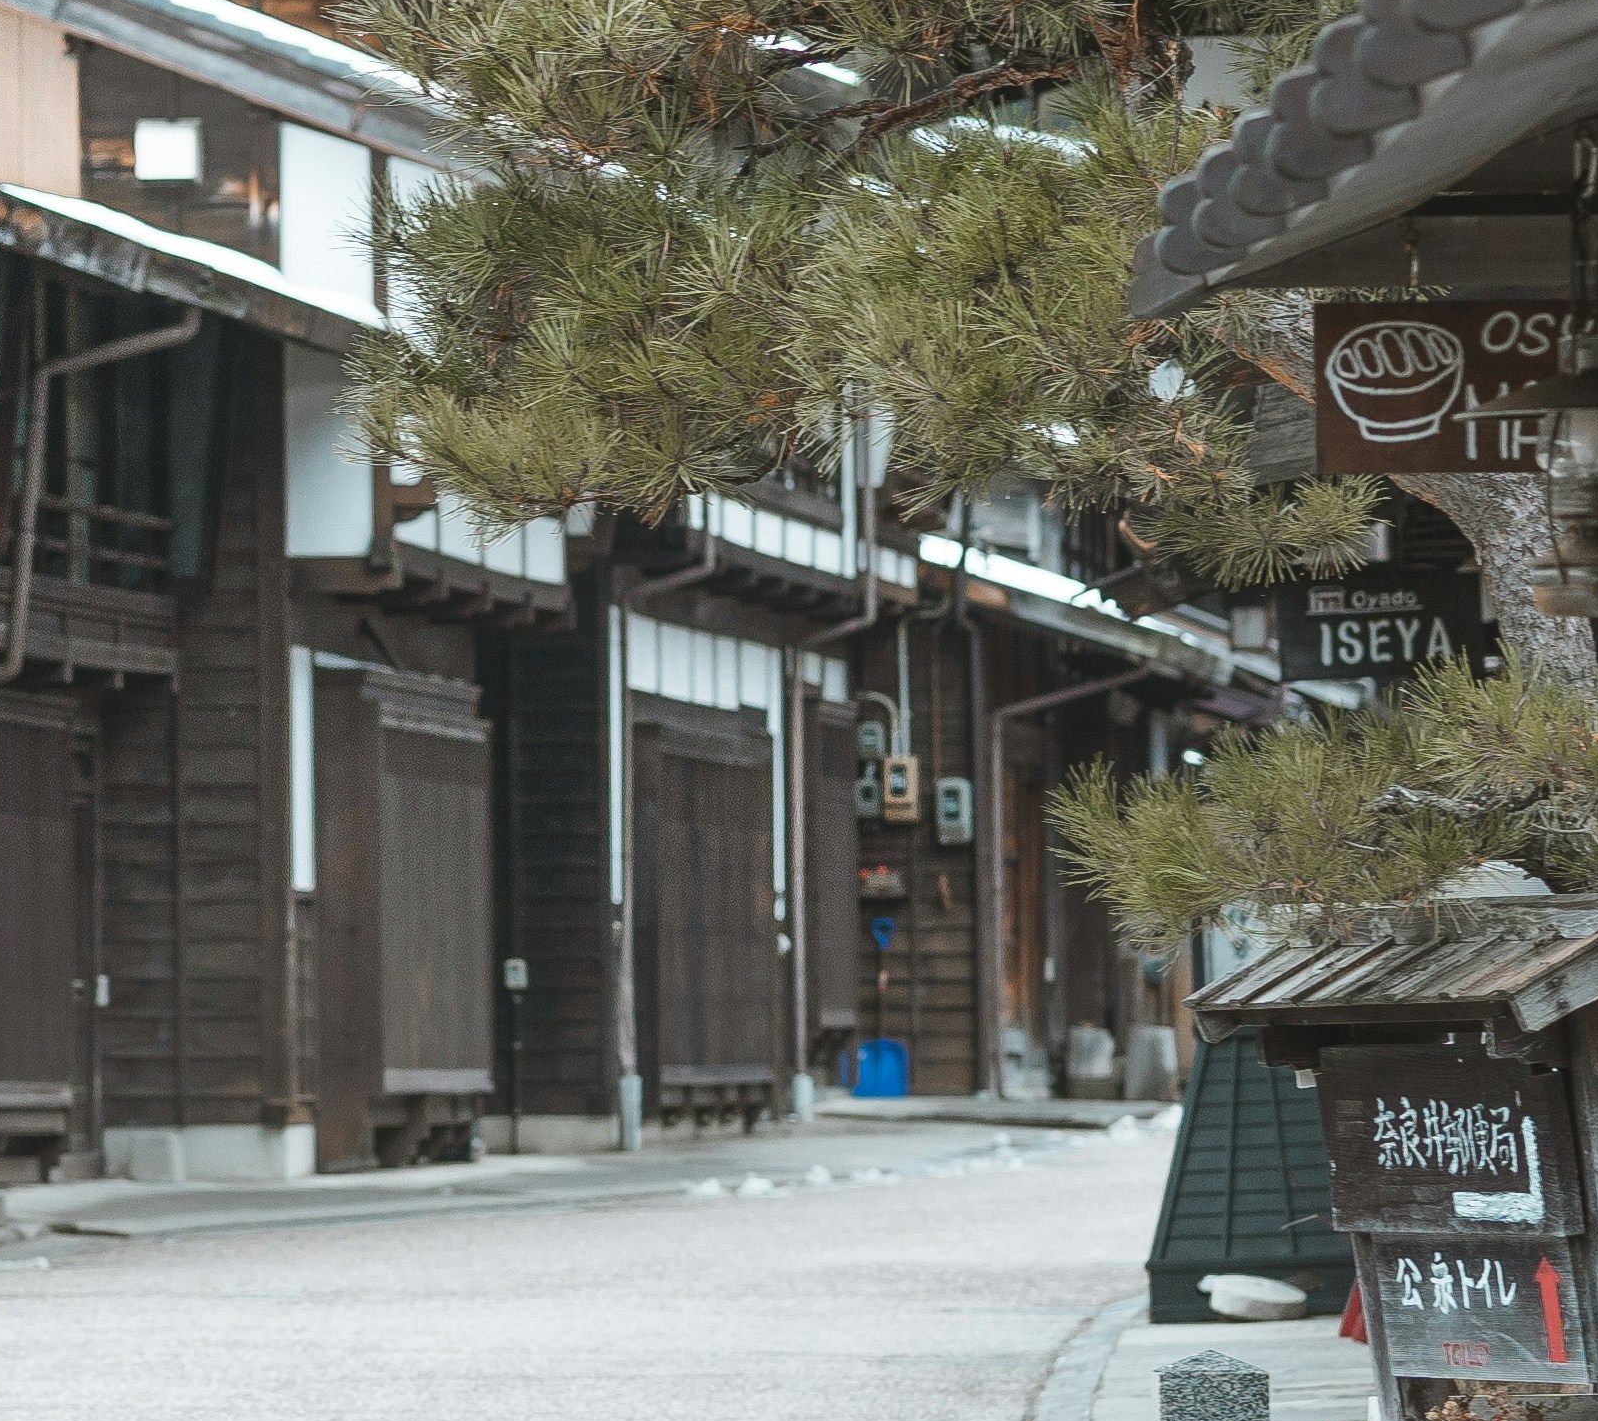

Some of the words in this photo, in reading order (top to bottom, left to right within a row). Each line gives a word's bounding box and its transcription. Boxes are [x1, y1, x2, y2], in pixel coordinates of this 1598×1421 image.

[1350, 589, 1418, 611] Oyado
[1319, 617, 1452, 667] ISEYA
[1373, 1096, 1520, 1177] 奈良井郵便局
[1396, 1251, 1518, 1316] 公衆トイレ
